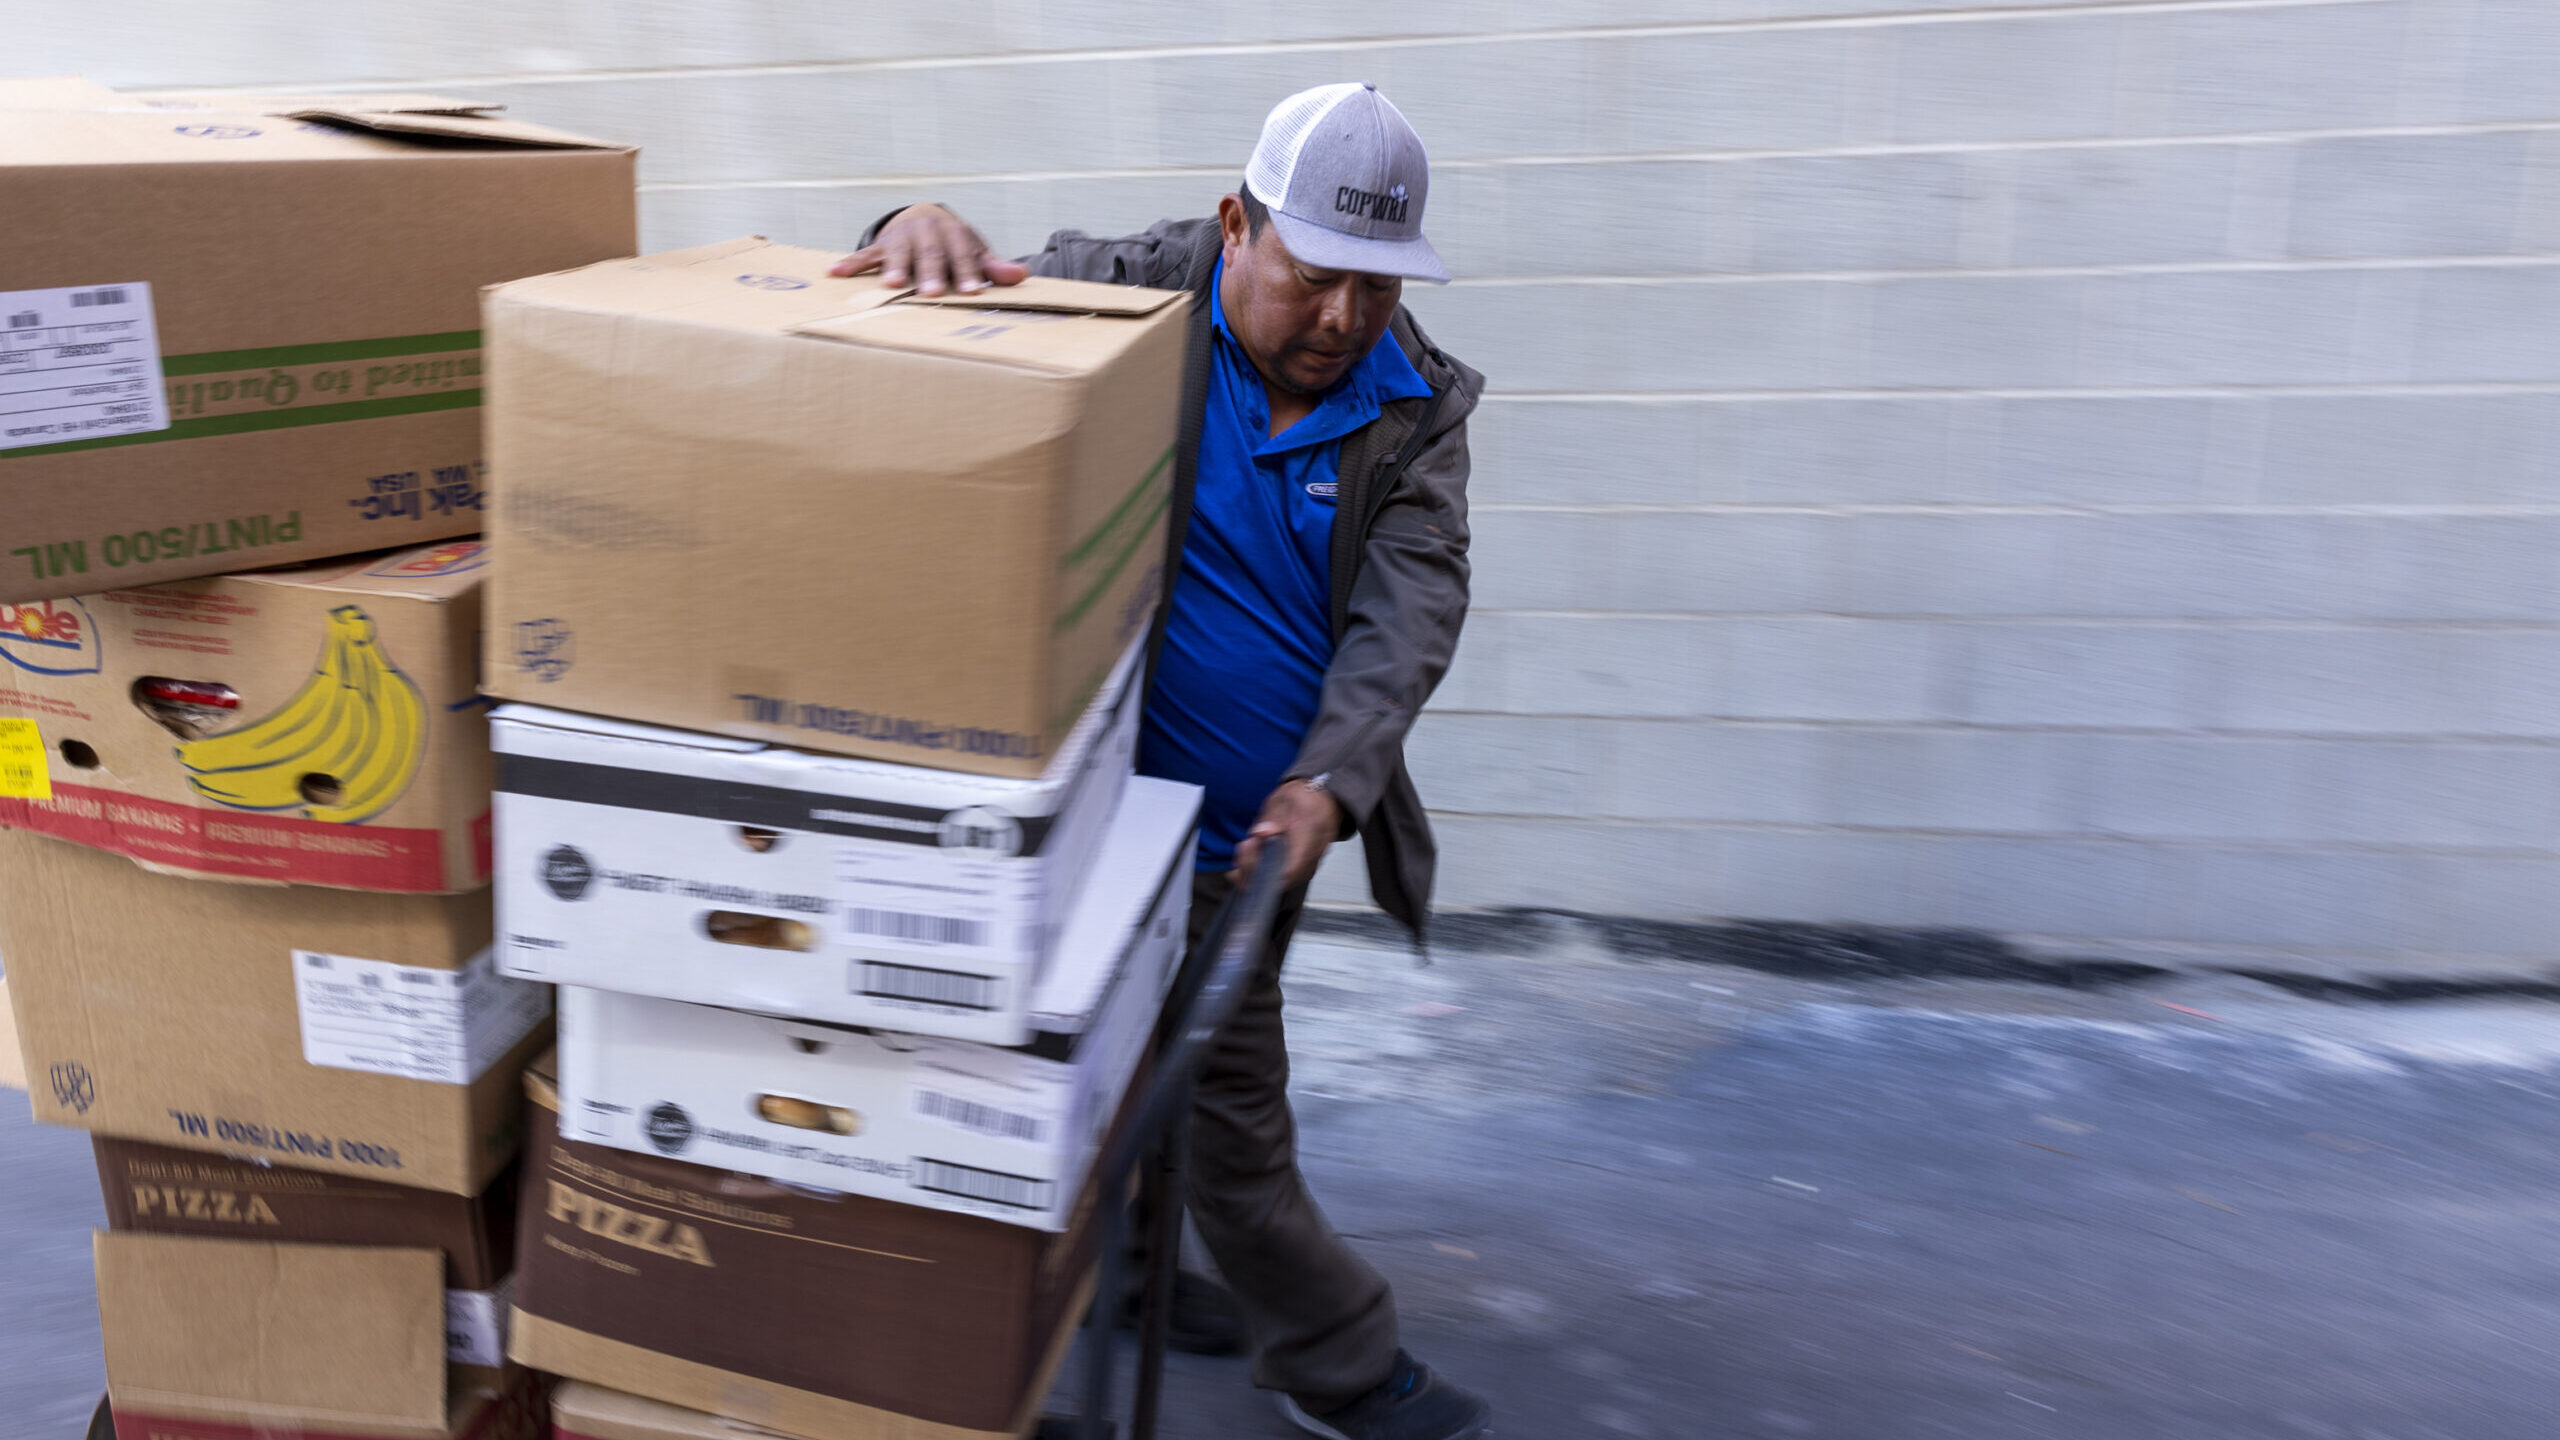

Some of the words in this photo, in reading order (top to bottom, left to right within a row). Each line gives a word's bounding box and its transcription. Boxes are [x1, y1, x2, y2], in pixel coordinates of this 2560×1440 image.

[311, 370, 350, 394] to
[366, 471, 421, 495] USA
[103, 509, 303, 567] PINT/500
[10, 540, 90, 579] ML
[105, 800, 187, 836] BANANAS
[167, 1106, 209, 1139] ML
[214, 1115, 334, 1161] PINT/500
[130, 1183, 281, 1226] PIZZA
[545, 1177, 717, 1269] PIZZA
